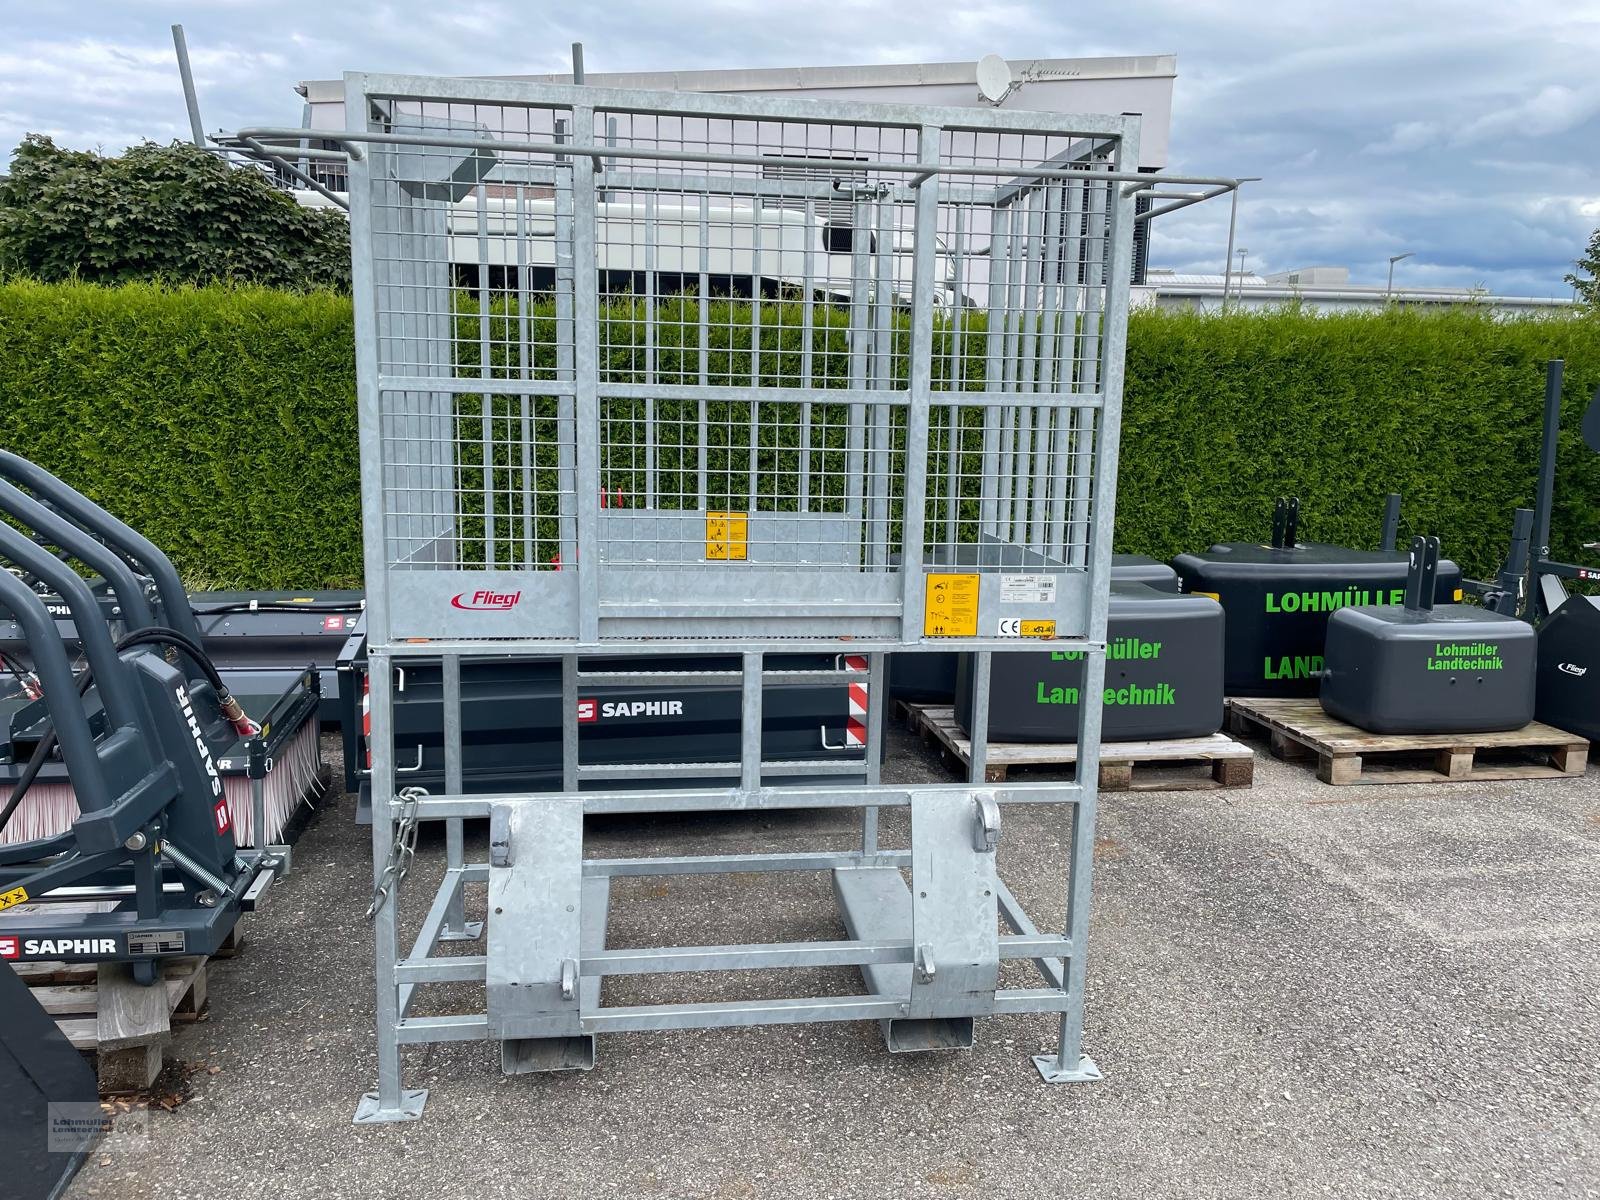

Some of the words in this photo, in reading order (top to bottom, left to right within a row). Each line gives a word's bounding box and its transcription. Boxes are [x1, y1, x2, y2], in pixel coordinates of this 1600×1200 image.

[472, 591, 521, 607] Fliegl
[1266, 585, 1406, 612] LOHMÜLLE
[1436, 642, 1498, 656] Lohmüller
[1427, 656, 1503, 670] Landtechnik
[602, 701, 683, 717] SAPHIR
[176, 685, 222, 797] SAPHIR
[24, 939, 117, 955] SAPHIR
